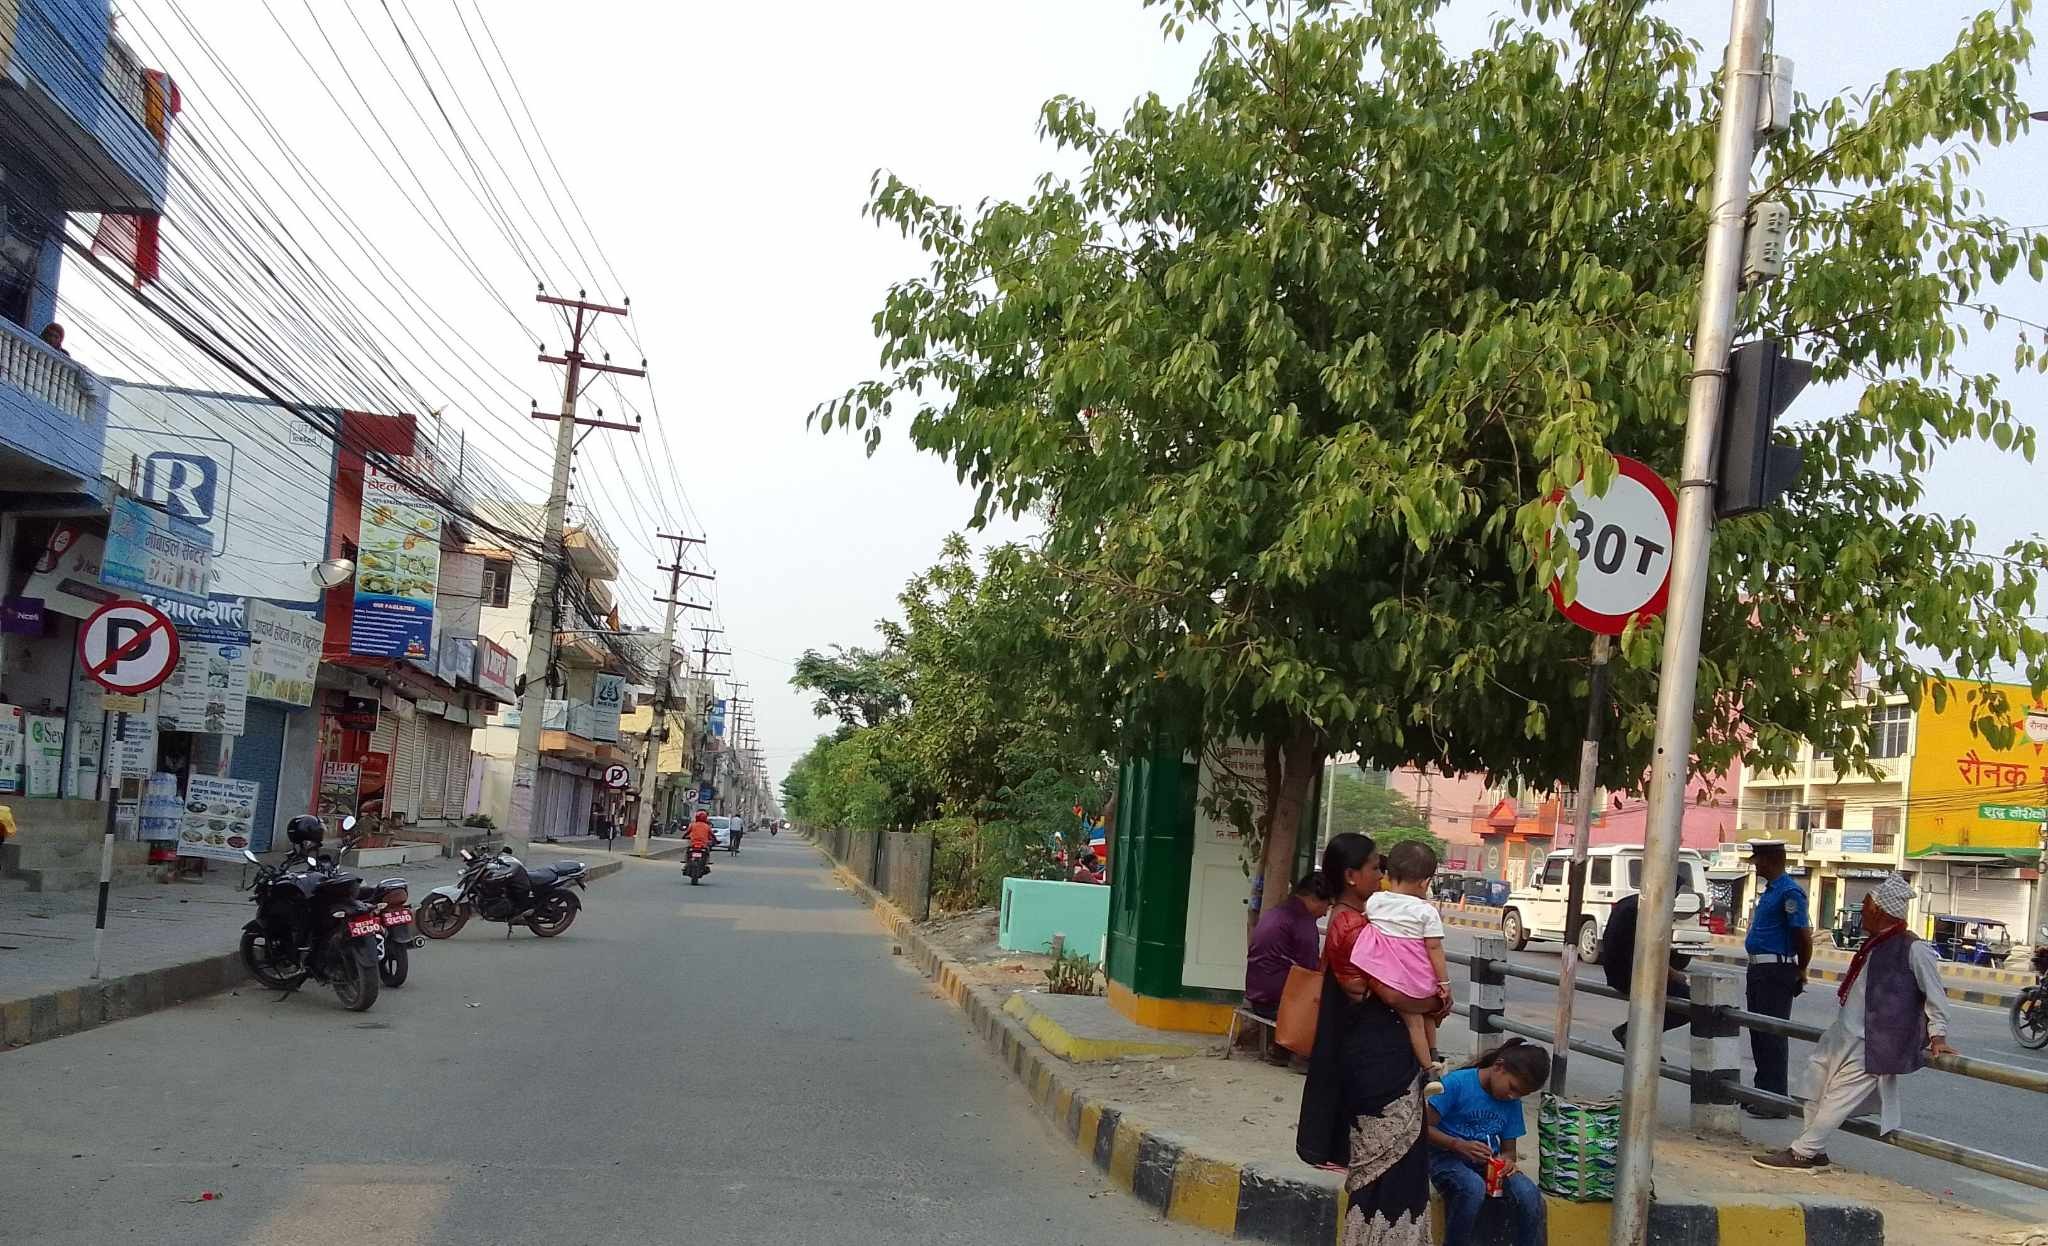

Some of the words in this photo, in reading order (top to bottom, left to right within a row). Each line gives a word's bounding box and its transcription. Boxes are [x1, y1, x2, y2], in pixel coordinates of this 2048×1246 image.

[1570, 511, 1665, 576] 30T
[105, 617, 151, 675] P
[1957, 749, 2028, 791] रौनक
